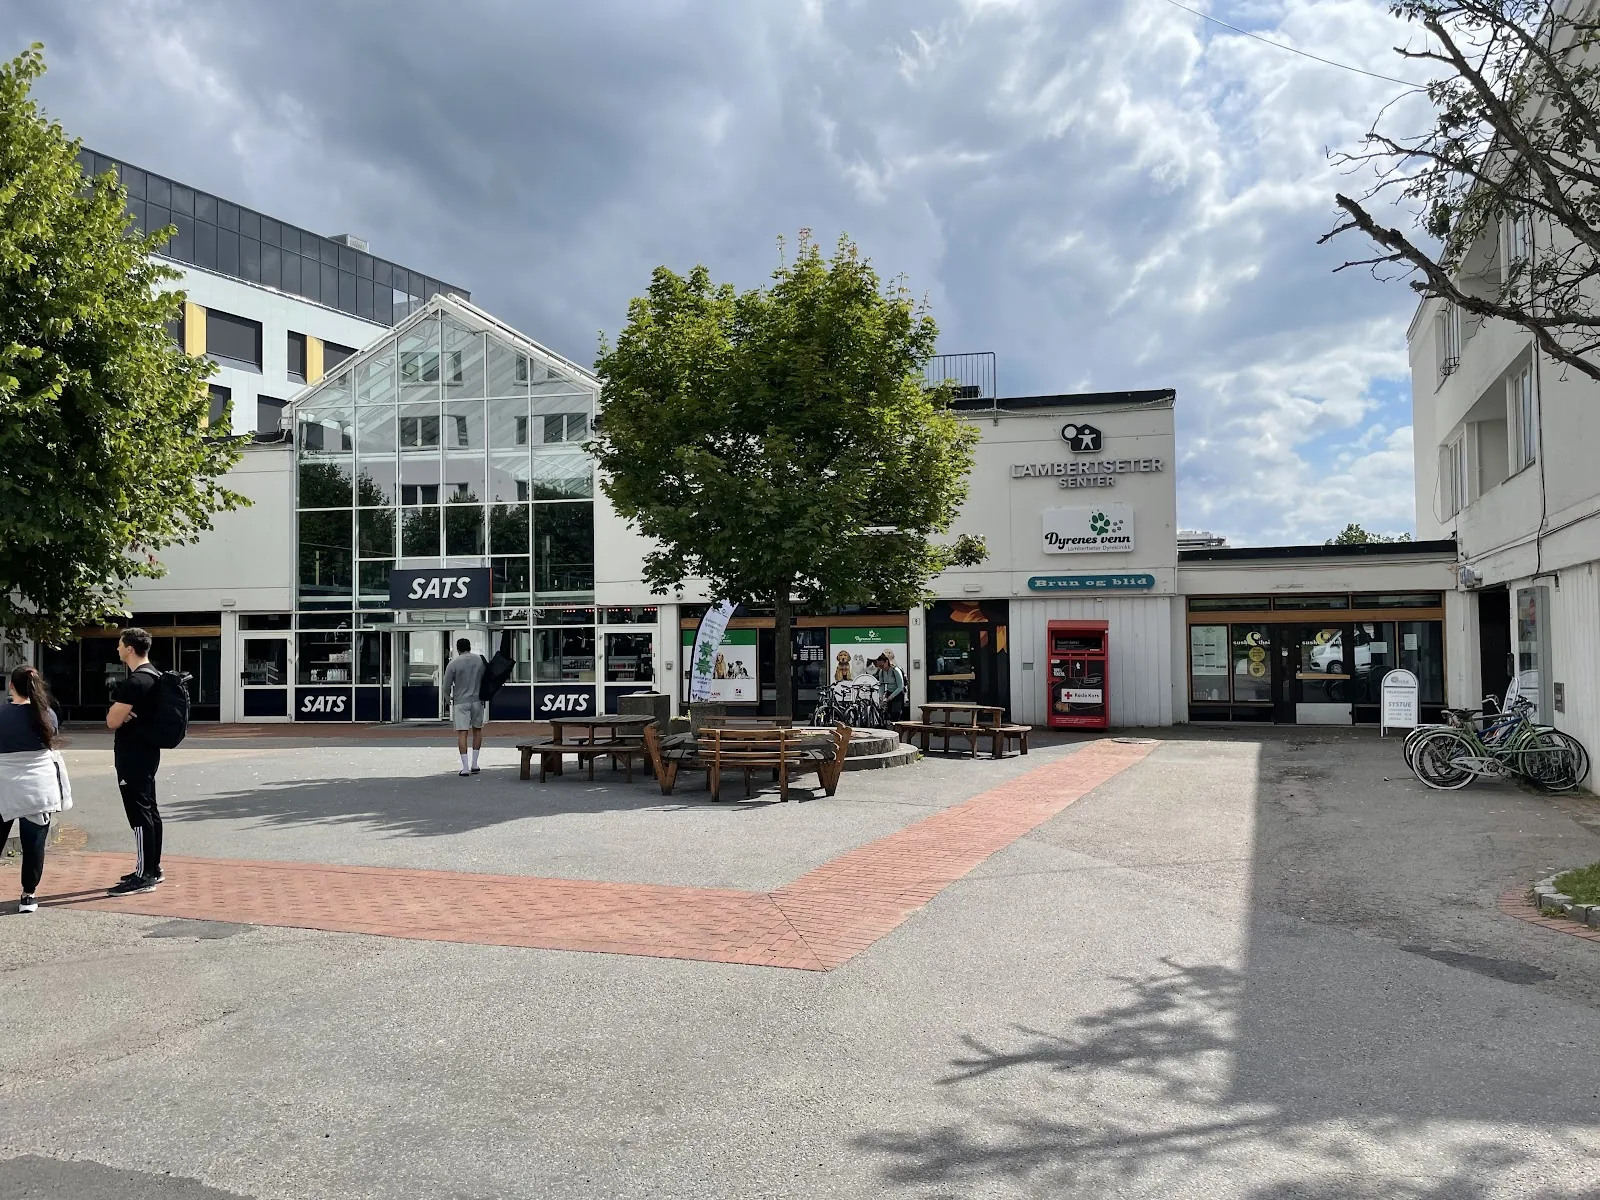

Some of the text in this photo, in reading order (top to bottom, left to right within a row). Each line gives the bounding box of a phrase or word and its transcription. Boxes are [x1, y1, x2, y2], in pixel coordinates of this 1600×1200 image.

[1011, 457, 1164, 479] LAMBERTSETER
[1059, 475, 1115, 489] SENTER
[1044, 532, 1131, 550] Dyrenes venn
[408, 576, 471, 600] SATS
[1034, 577, 1148, 588] Brun og blid
[301, 695, 347, 713] SATS
[540, 693, 590, 712] SATS
